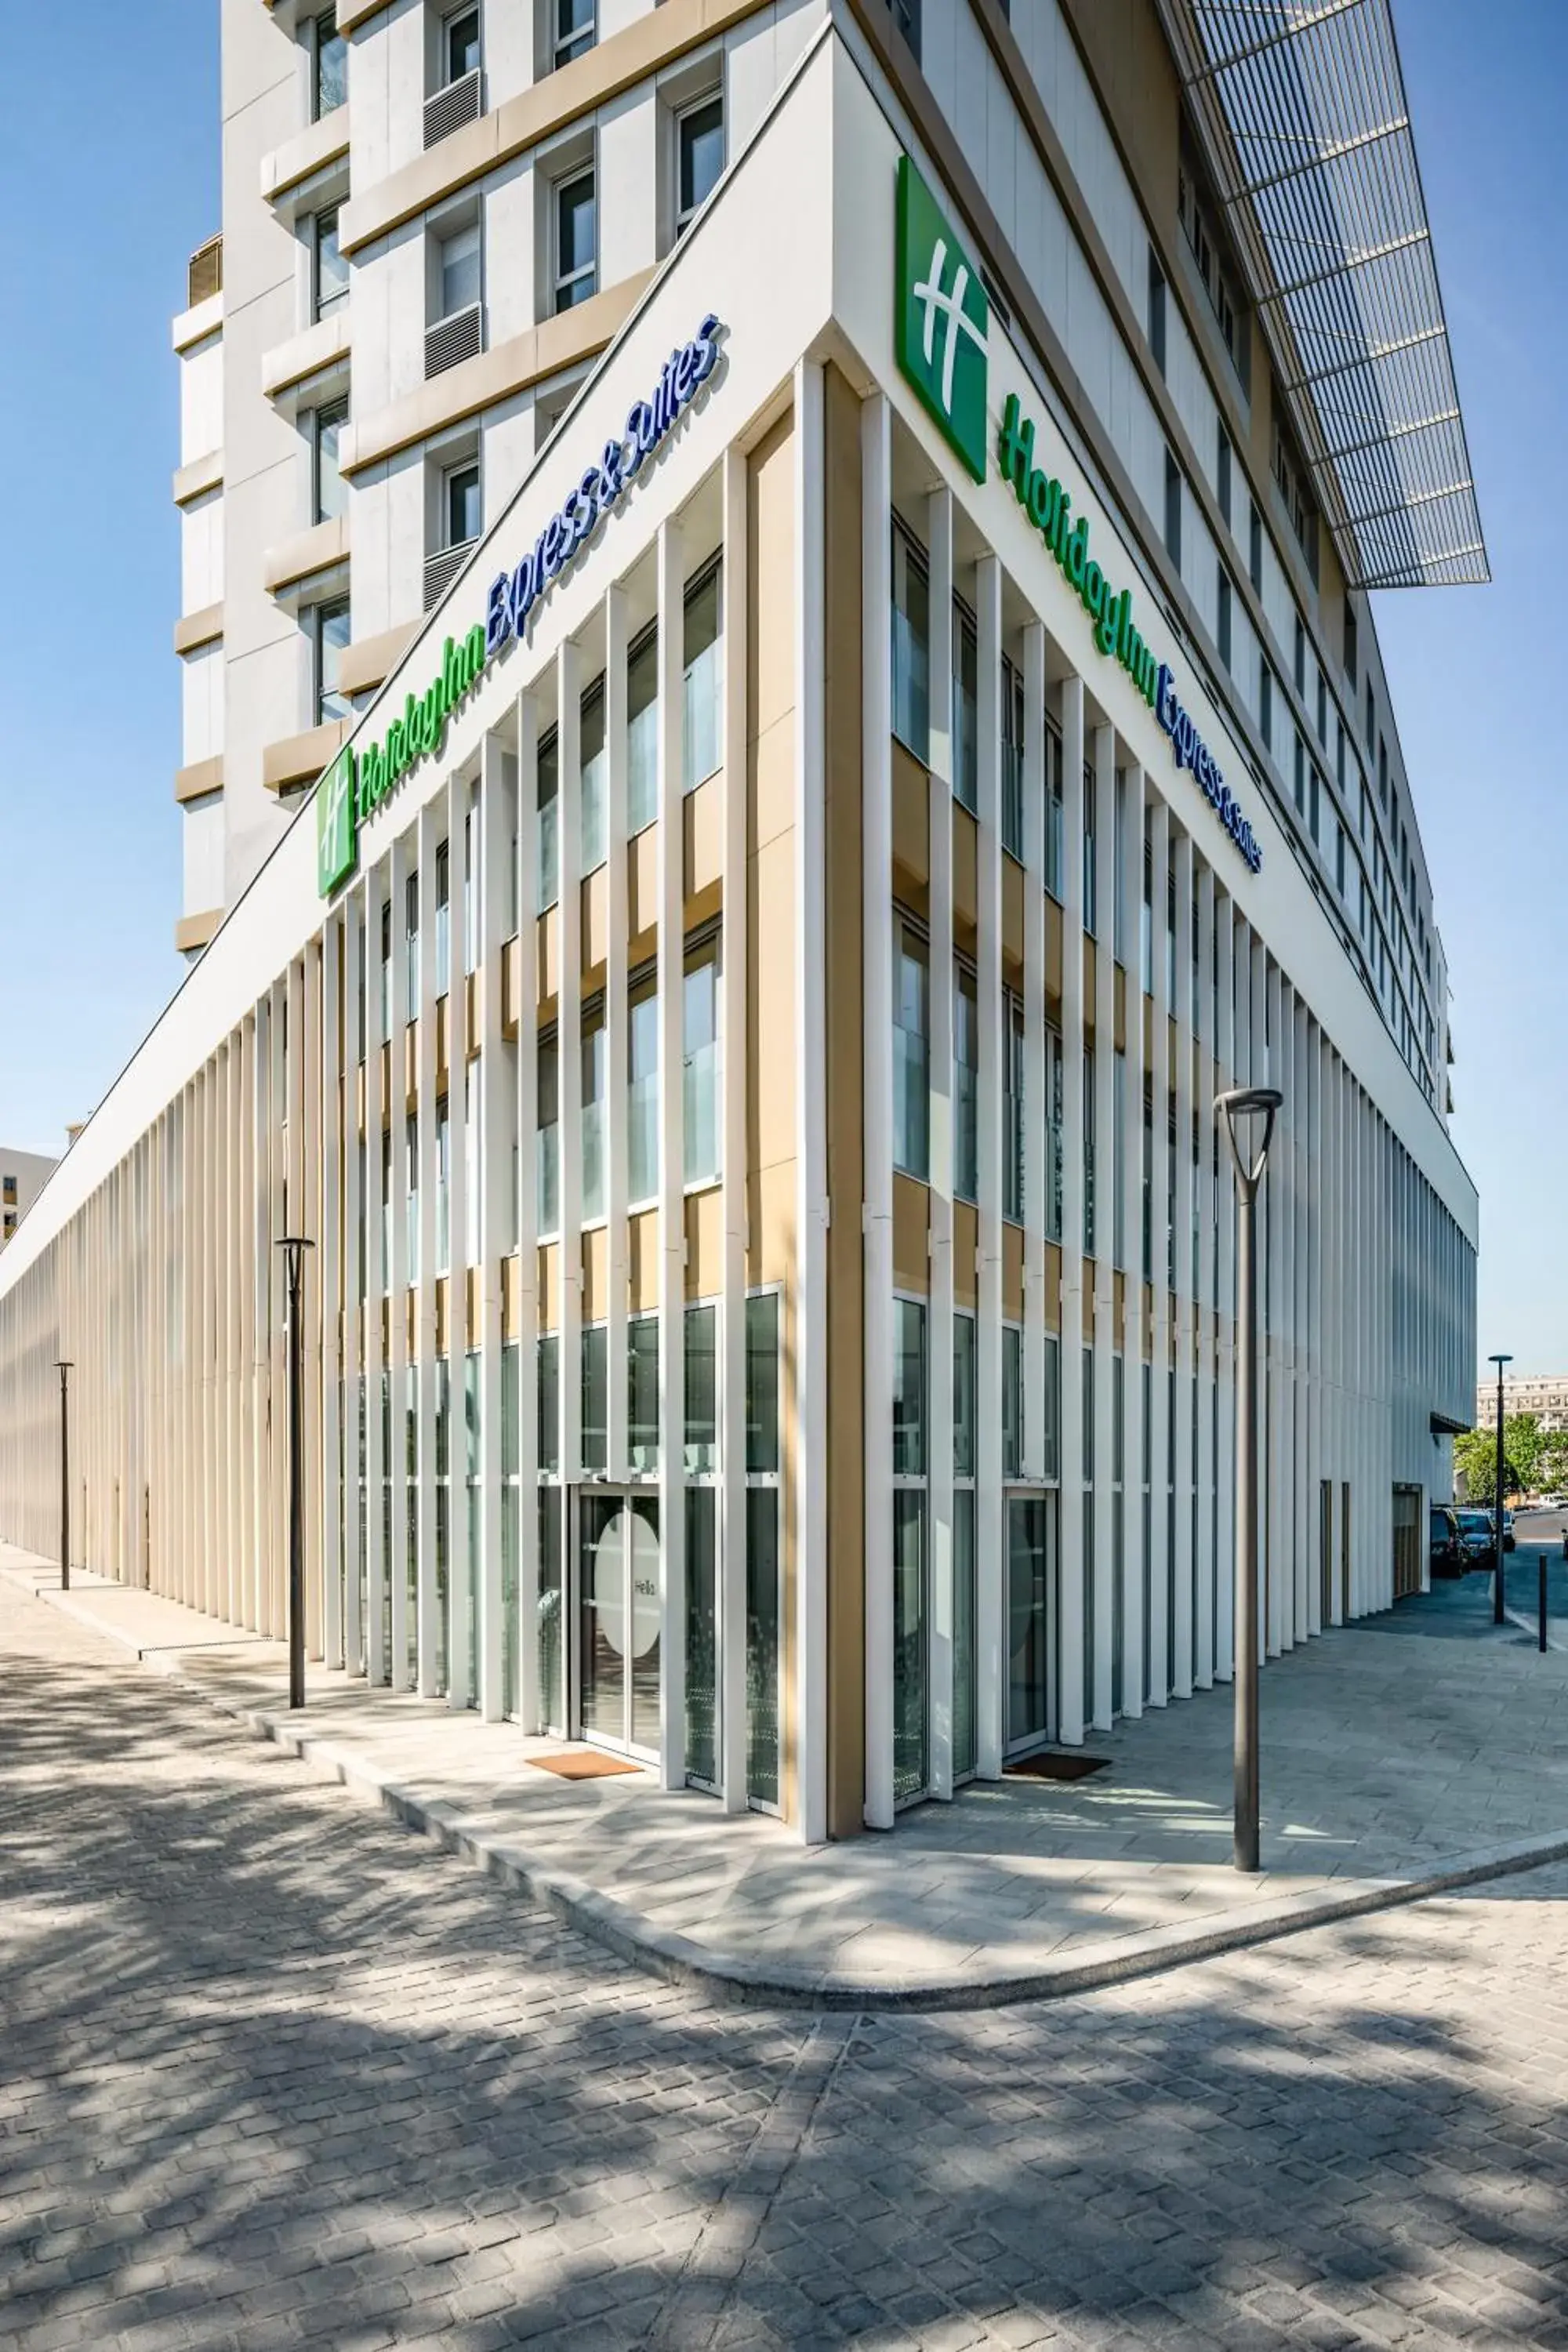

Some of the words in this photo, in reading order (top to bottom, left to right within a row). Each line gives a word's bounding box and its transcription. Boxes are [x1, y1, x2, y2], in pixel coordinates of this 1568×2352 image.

[358, 677, 443, 819] Holiday
[441, 623, 485, 713] Inn
[486, 466, 600, 655] Express
[598, 439, 622, 508] &
[623, 314, 719, 477] Suites
[1000, 393, 1120, 655] Holiday
[1117, 589, 1156, 707] Inn
[1156, 664, 1223, 809] Express
